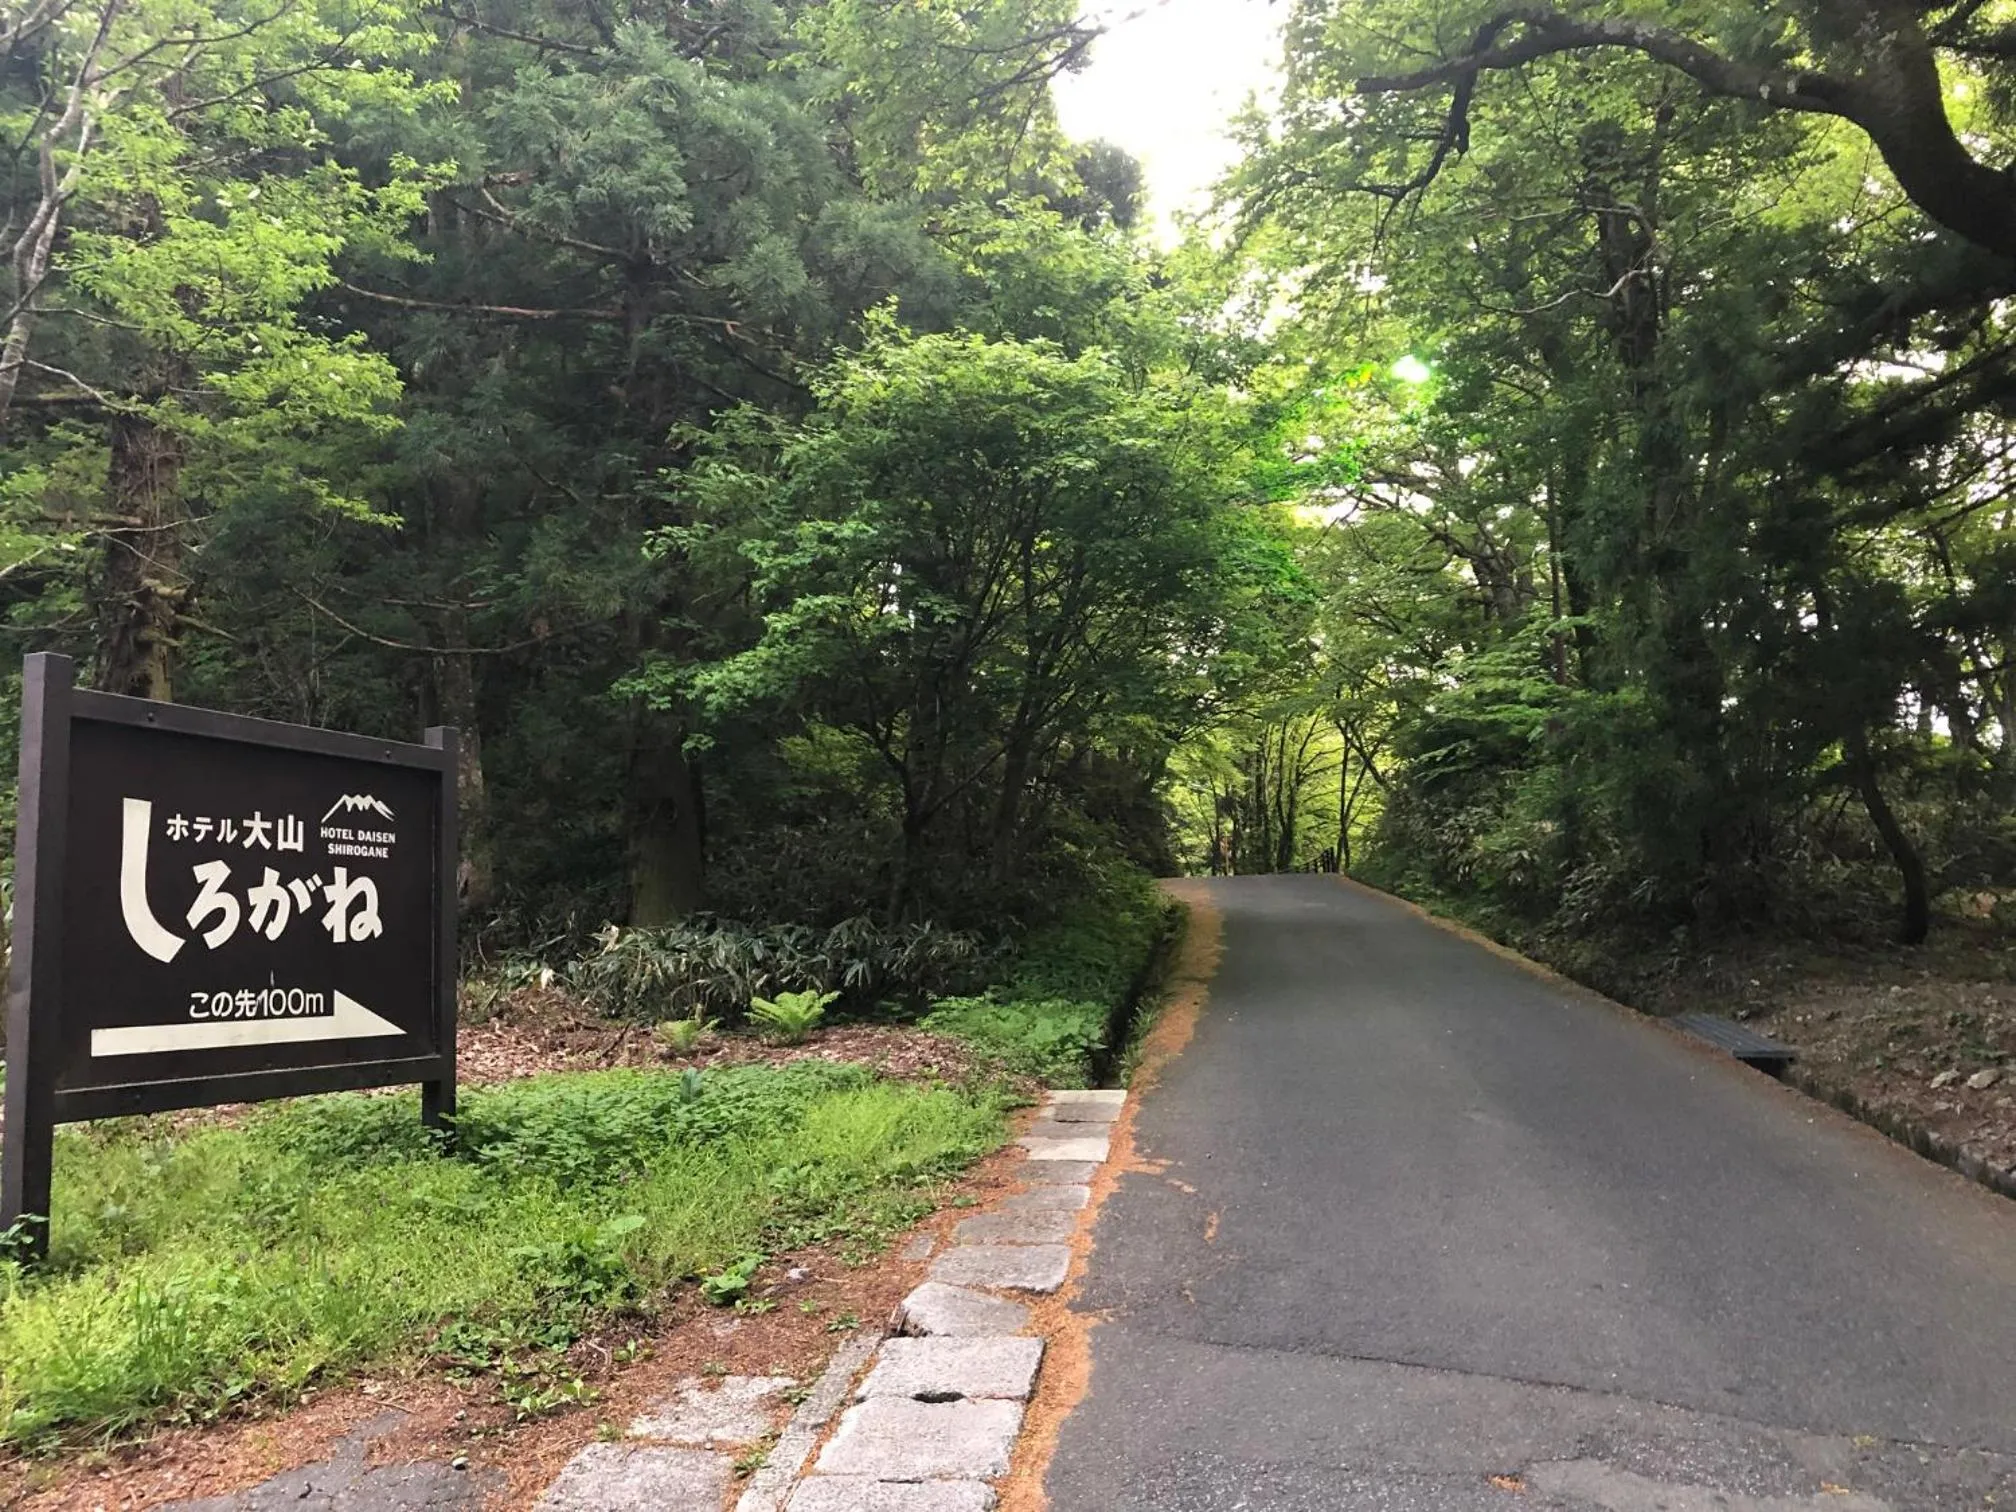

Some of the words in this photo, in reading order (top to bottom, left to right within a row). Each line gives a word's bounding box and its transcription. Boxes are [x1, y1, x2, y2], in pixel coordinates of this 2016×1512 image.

[166, 811, 304, 853] ホテル大山
[320, 826, 354, 841] HOTEL
[358, 829, 396, 844] DAISEN
[327, 843, 389, 859] SHIROGANE
[120, 797, 383, 963] しろがね
[189, 987, 324, 1019] この先100m
